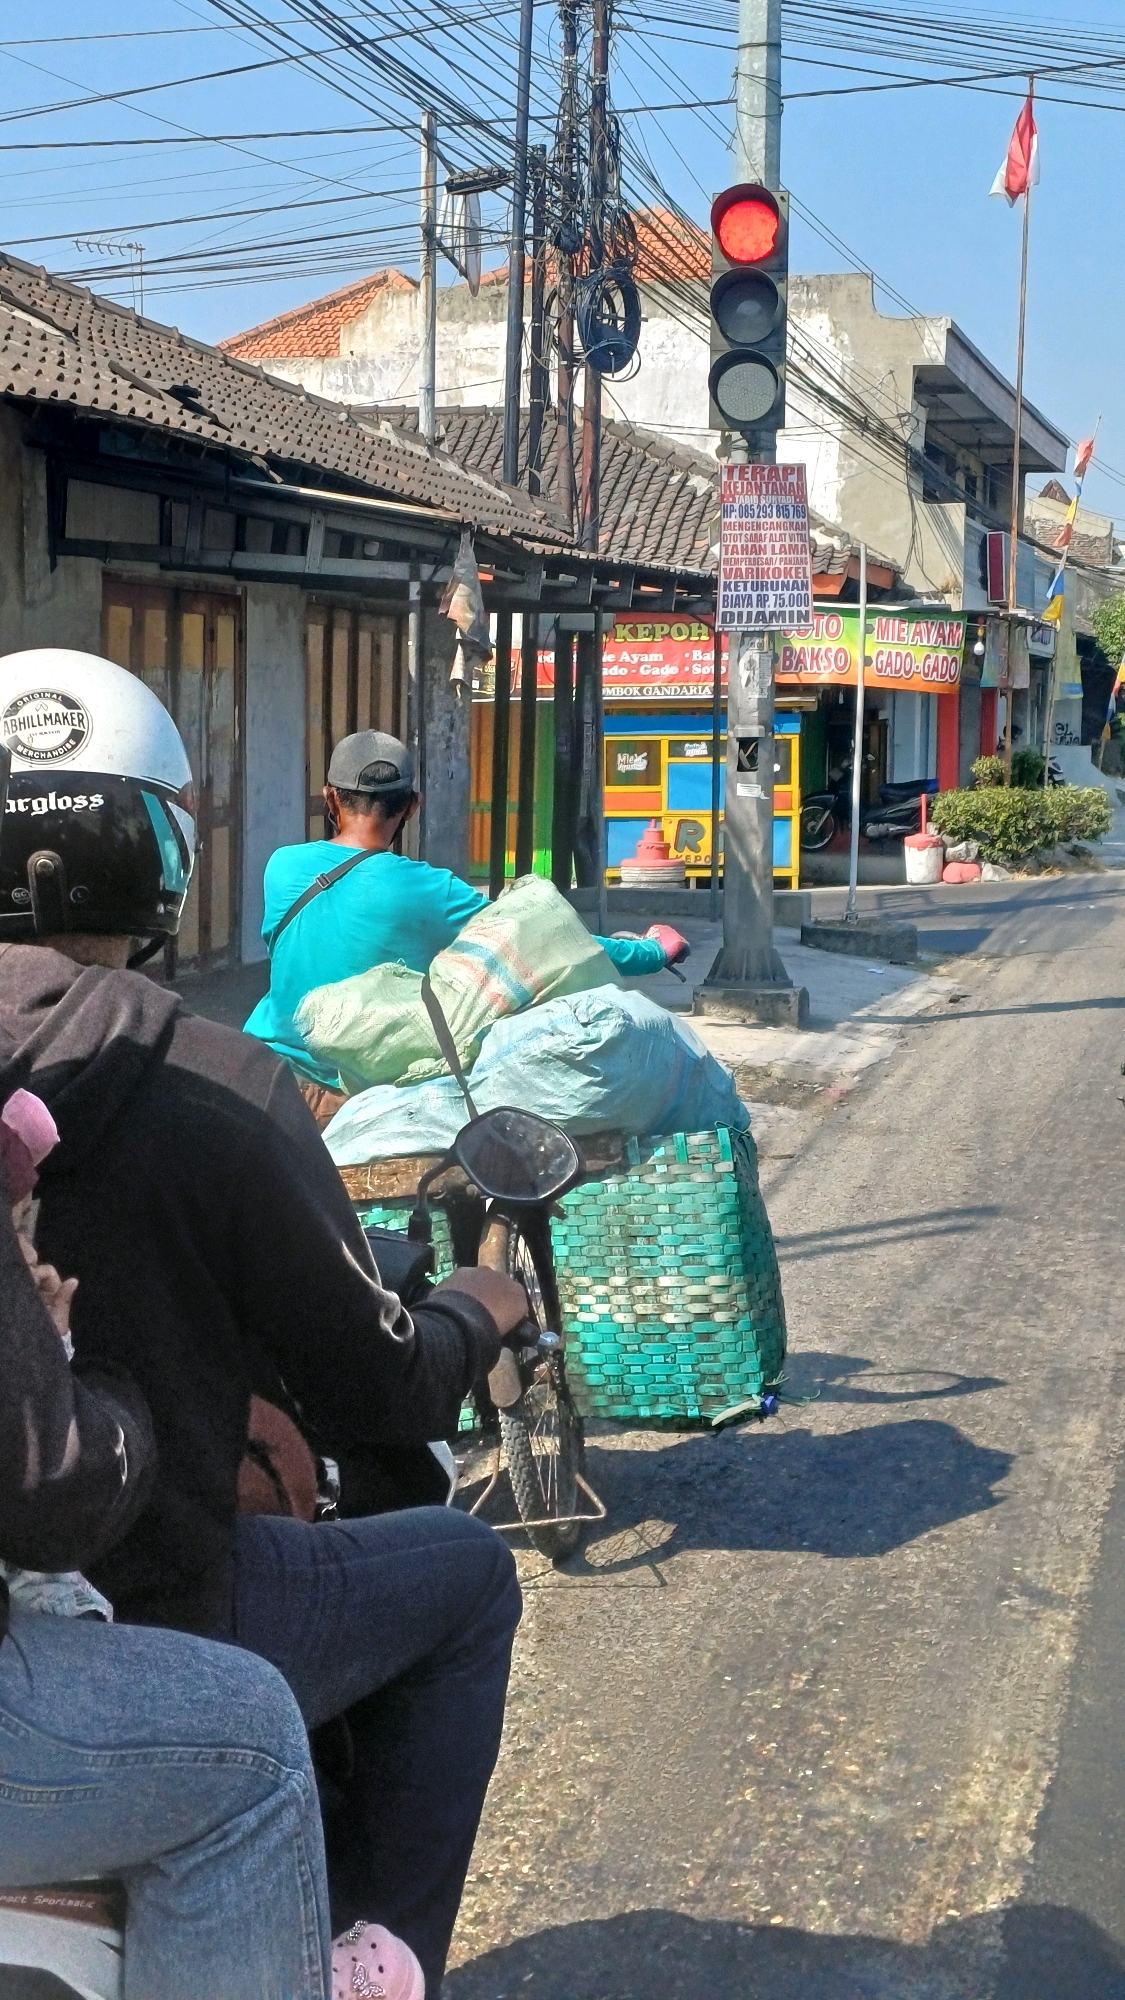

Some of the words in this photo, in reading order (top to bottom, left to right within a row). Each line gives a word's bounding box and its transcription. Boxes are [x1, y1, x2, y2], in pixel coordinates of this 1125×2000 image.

[724, 465, 804, 482] TERAPI
[723, 481, 805, 495] KEJANTANAN
[760, 495, 794, 504] SURYADI
[723, 504, 737, 519] HP:
[738, 504, 755, 519] 085
[757, 504, 773, 519] 293
[776, 504, 790, 519] 815
[792, 504, 806, 519] 769
[723, 521, 807, 532] MENGENCANGKAN
[722, 533, 742, 543] OTOT
[744, 533, 767, 543] SARAF
[769, 533, 787, 543] ALAT
[789, 533, 808, 543] VITAL
[723, 544, 767, 556] TAHAN
[771, 544, 808, 556] LAMA
[723, 567, 810, 580] VARIKOKEL
[722, 580, 810, 592] KETURUNAN
[722, 594, 754, 609] BIAYA
[756, 594, 771, 609] RP.
[773, 593, 810, 608] 75.000
[721, 610, 810, 625] DIJAMIN
[614, 622, 710, 642] KEPOH
[875, 617, 908, 644] MIE
[909, 620, 963, 649] AYAM
[618, 651, 664, 664] Ayam
[780, 645, 851, 675] BAKSO
[602, 664, 628, 676] ado
[639, 664, 680, 676] Gado
[642, 684, 712, 696] GANDARIA
[16, 738, 77, 759] MERCHANDISE
[5, 791, 104, 816] argloss
